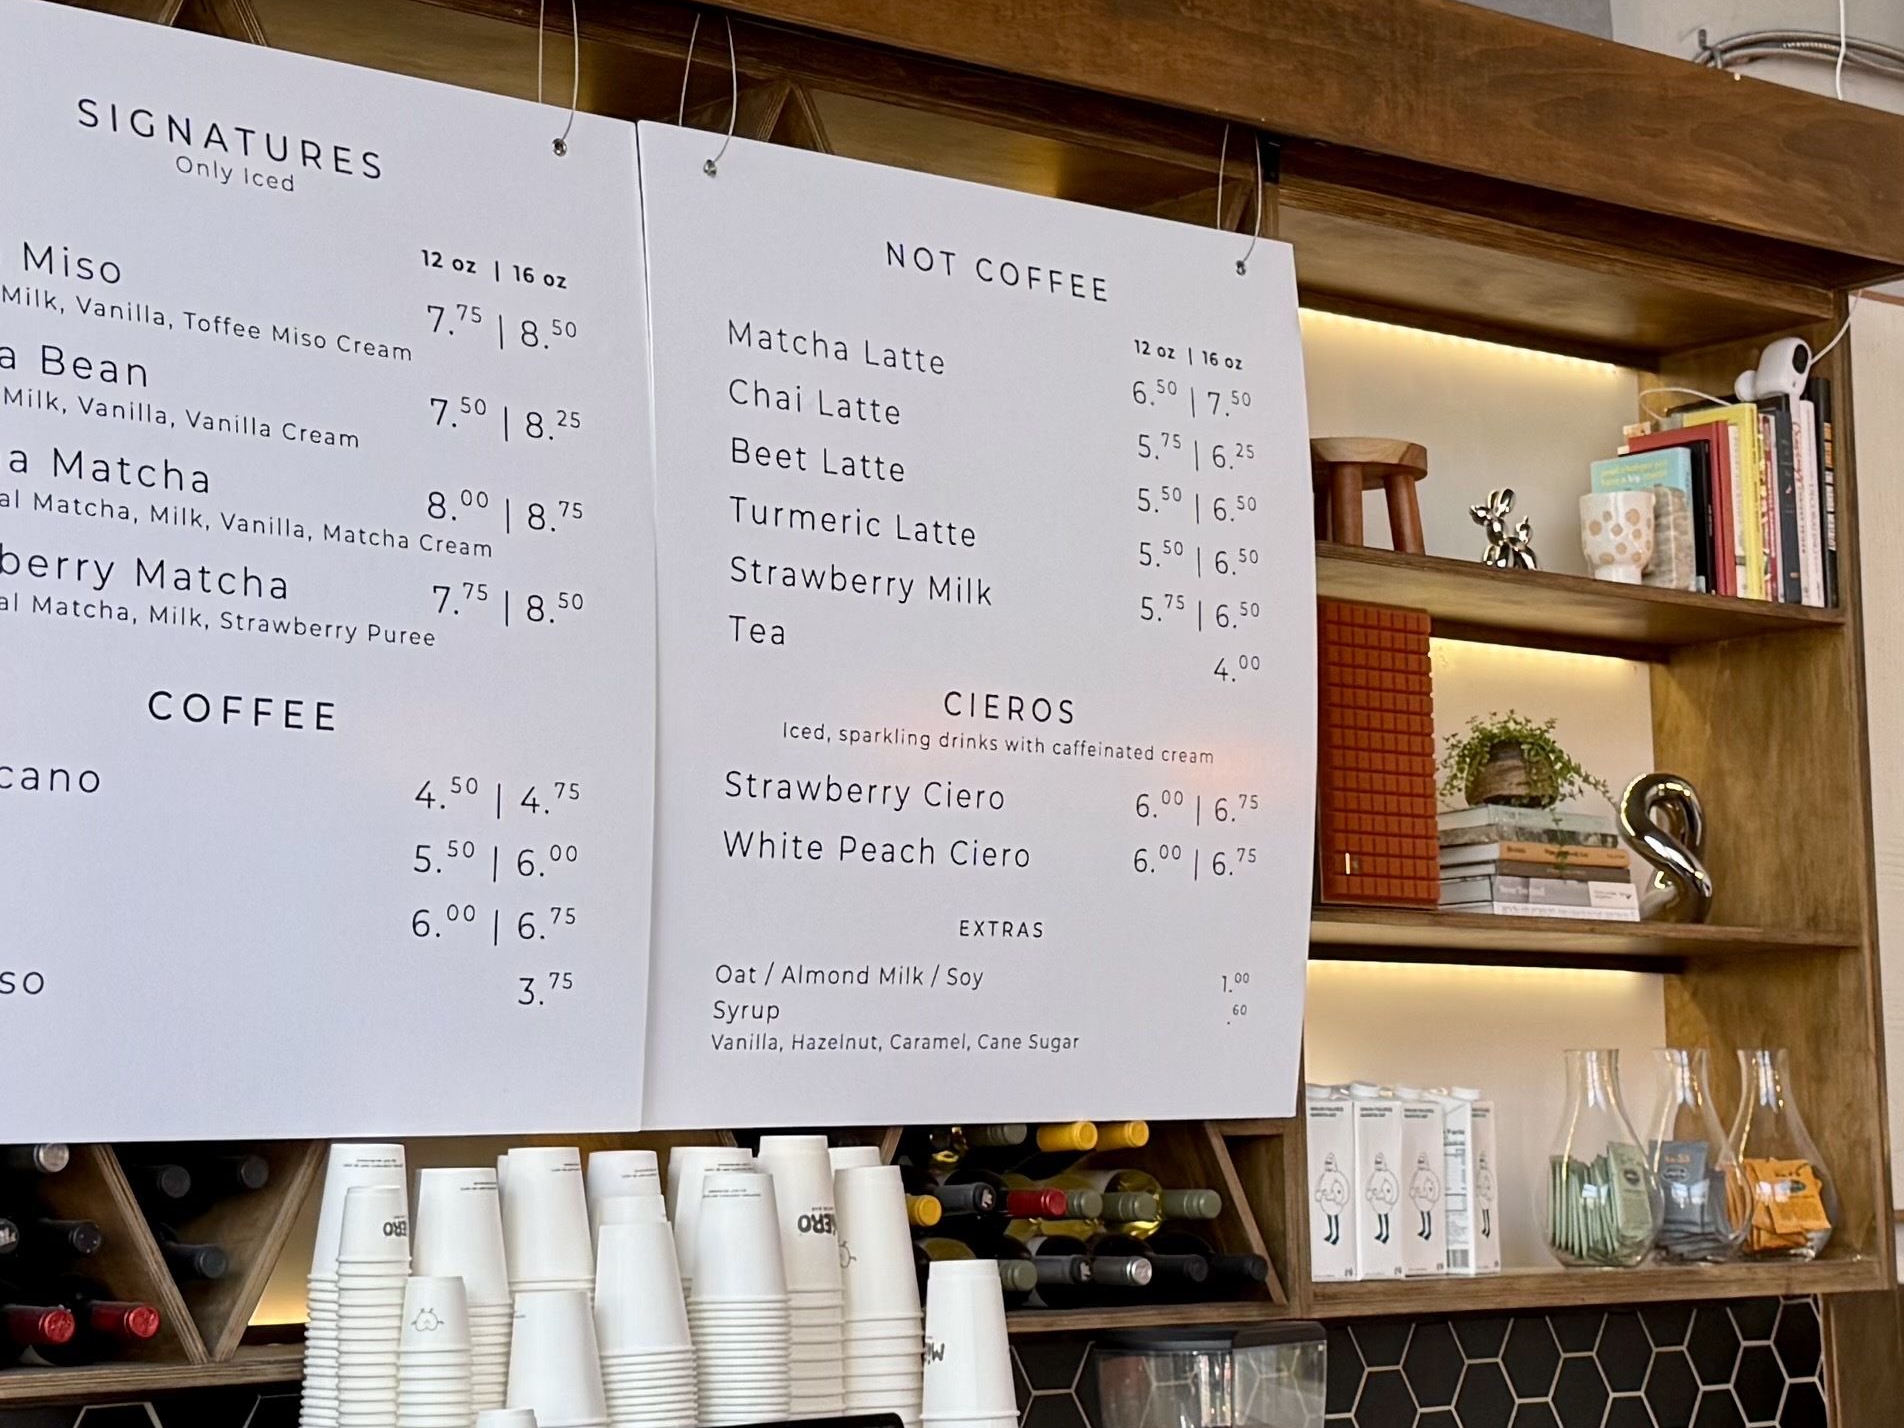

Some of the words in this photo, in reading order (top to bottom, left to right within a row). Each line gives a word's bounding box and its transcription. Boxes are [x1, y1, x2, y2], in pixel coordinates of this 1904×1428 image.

[78, 99, 381, 180] SIGNATURES
[176, 156, 232, 184] Only
[244, 168, 294, 192] Iced
[24, 241, 120, 290] Miso
[887, 241, 956, 276] NOT
[976, 258, 1107, 302] COFFEE
[2, 284, 64, 314] Milk,
[76, 295, 172, 330] Vanilla,
[183, 312, 260, 339] Toffee
[273, 325, 326, 348] Miso
[337, 335, 411, 361] Cream
[42, 345, 146, 387] Bean
[729, 319, 847, 361] Matcha
[865, 340, 944, 375] Latte
[4, 386, 66, 415] Milk,
[78, 396, 174, 428] Vanilla,
[185, 409, 270, 437] Vanilla
[282, 423, 358, 448] Cream
[729, 379, 800, 412] Chai
[819, 389, 900, 425] Latte
[54, 447, 208, 493] Matcha
[732, 437, 806, 471] Beet
[824, 448, 904, 482] Latte
[34, 492, 137, 524] Matcha,
[151, 504, 209, 531] Milk,
[220, 512, 311, 542] Vanilla,
[324, 524, 408, 548] Matcha
[420, 534, 491, 557] Cream
[729, 496, 880, 537] Turmeric
[897, 514, 975, 547] Latte
[137, 557, 286, 599] Matcha
[731, 556, 913, 604] Strawberry
[930, 575, 991, 606] Milk
[33, 595, 136, 625] Matcha,
[150, 605, 208, 630] Milk,
[221, 611, 357, 644] Strawberry
[369, 624, 435, 646] Puree
[729, 615, 784, 645] Tea
[148, 691, 334, 731] COFFEE
[944, 691, 1073, 724] CIEROS
[784, 722, 830, 743] Iced,
[839, 728, 930, 750] sparkling
[939, 732, 997, 751] drinks
[1005, 736, 1044, 753] with
[1053, 740, 1153, 760] caffeinated
[1162, 750, 1213, 764] cream
[725, 771, 910, 811] Strawberry
[924, 781, 1004, 810] Ciero
[724, 830, 823, 860] White
[840, 836, 934, 864] Peach
[951, 839, 1029, 867] Ciero
[960, 920, 1042, 938] EXTRAS
[716, 964, 756, 984] Oat
[781, 964, 869, 984] Almond
[880, 966, 923, 985] Milk
[947, 967, 983, 990] Soy
[713, 1000, 779, 1024] Syrup
[712, 1033, 783, 1052] Vanilla,
[792, 1034, 882, 1052] Hazelnut,
[890, 1033, 970, 1051] Caramel,
[978, 1034, 1022, 1049] Cane
[1029, 1034, 1079, 1053] Sugar
